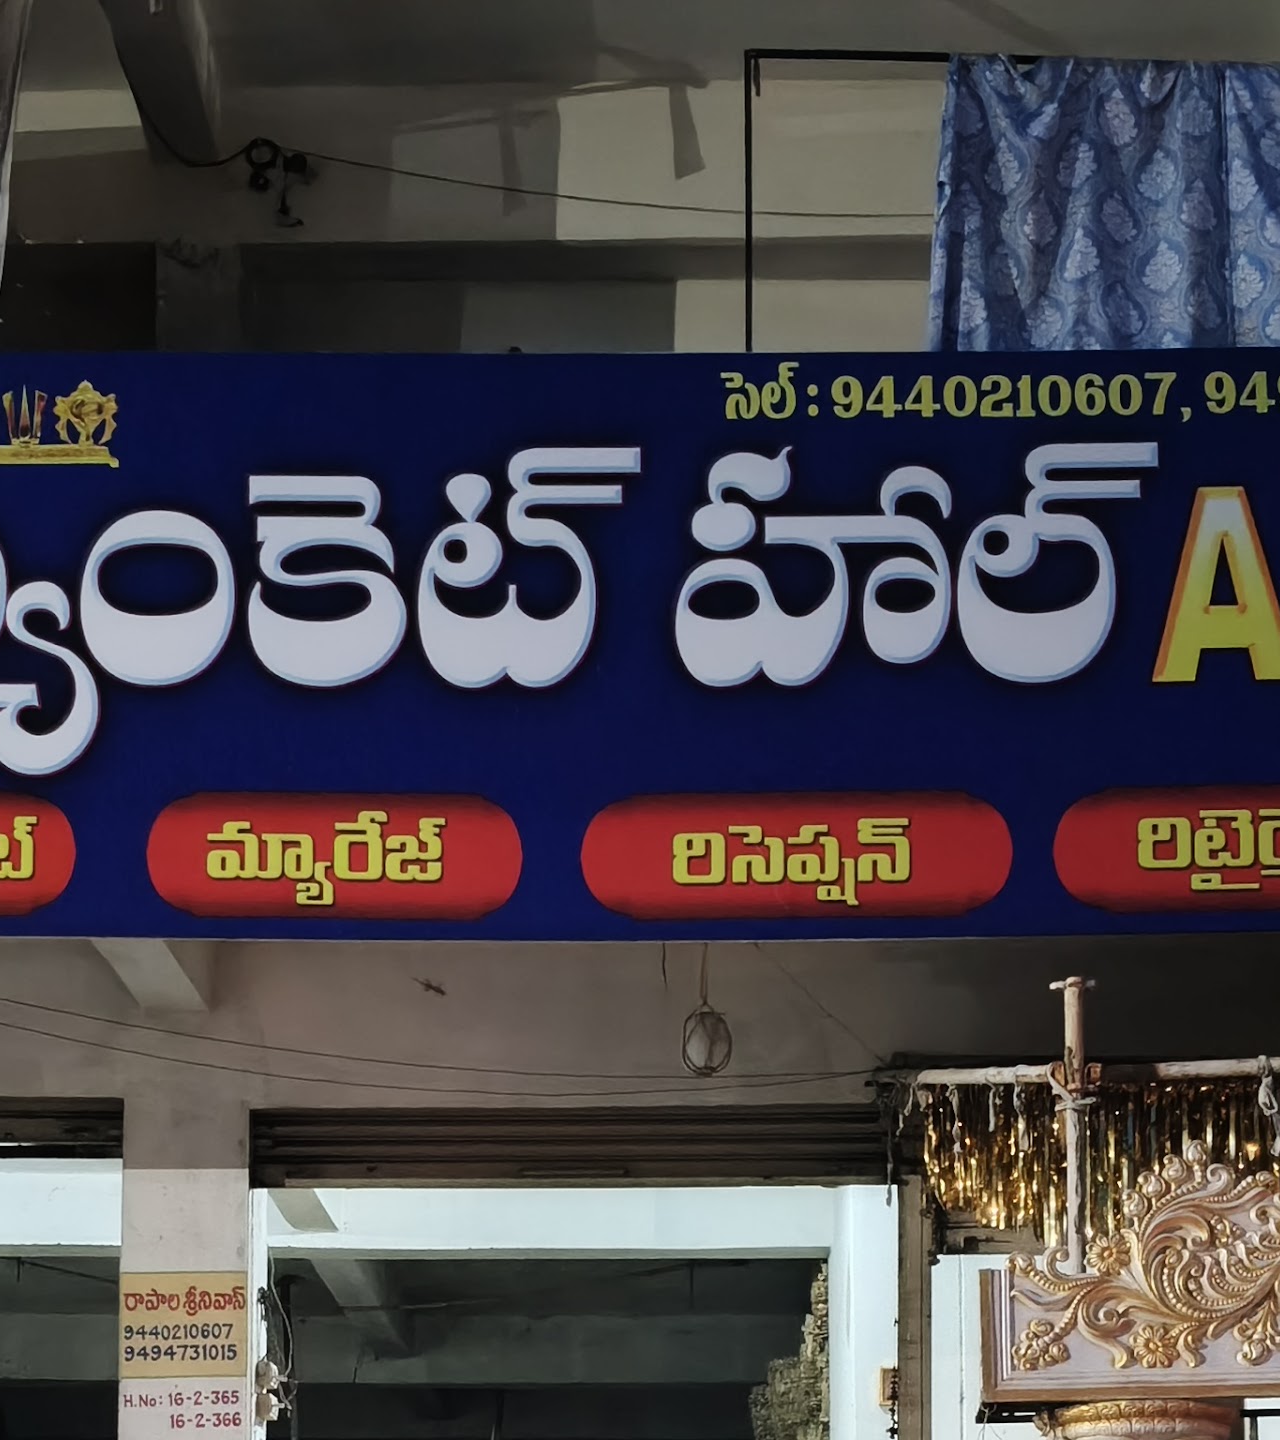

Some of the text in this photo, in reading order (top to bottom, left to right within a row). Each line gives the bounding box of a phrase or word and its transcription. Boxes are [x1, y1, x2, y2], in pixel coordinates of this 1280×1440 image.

[830, 373, 1192, 422] 9440210607,
[675, 442, 1159, 687] హాల్
[206, 810, 446, 905] మ్యారేజ్
[672, 817, 910, 906] రిసెప్షన్
[182, 1285, 246, 1316] శ్రీనివాస్
[123, 1323, 233, 1341] 9440210607
[124, 1343, 237, 1361] 9494731015
[168, 1390, 240, 1407] 16-2-365
[170, 1411, 242, 1429] 16-2-366
